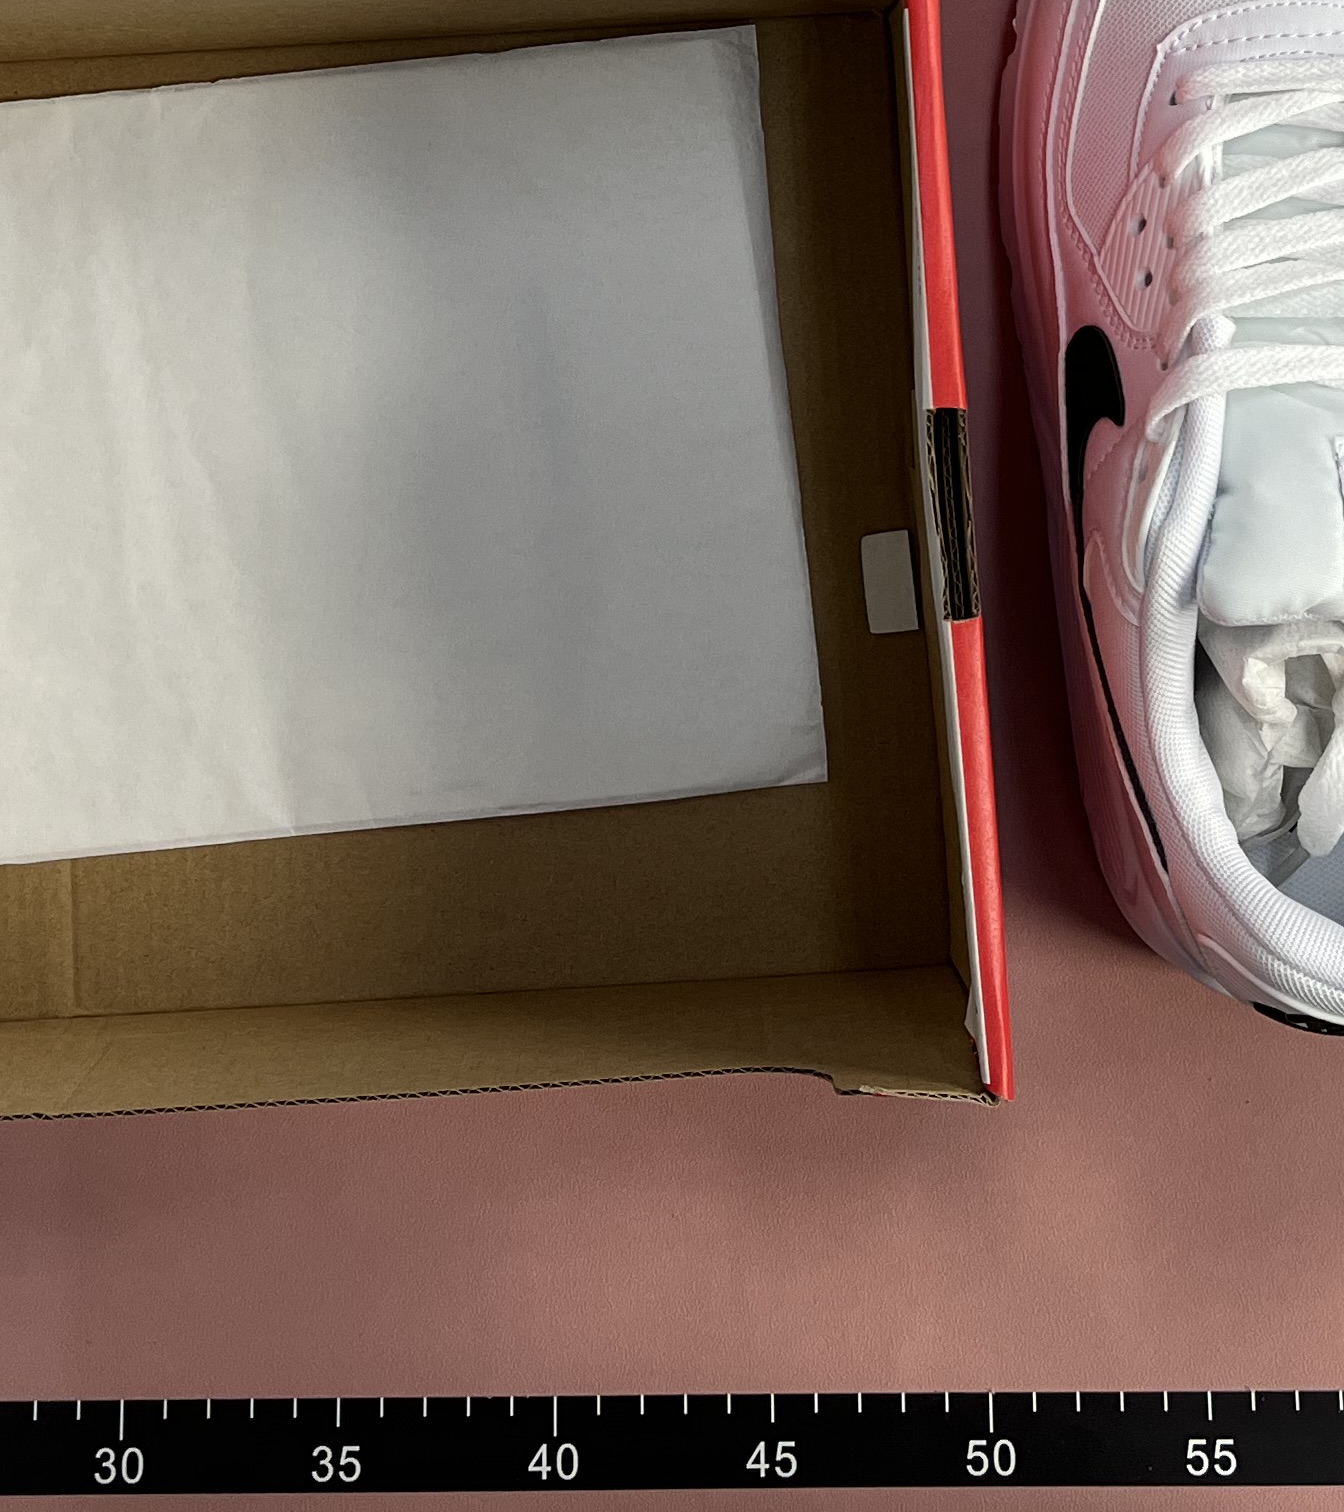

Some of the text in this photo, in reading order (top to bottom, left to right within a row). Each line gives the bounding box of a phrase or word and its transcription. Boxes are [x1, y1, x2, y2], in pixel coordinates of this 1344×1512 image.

[94, 1447, 144, 1484] 30
[311, 1445, 361, 1483] 35
[527, 1443, 579, 1481] 40
[746, 1441, 798, 1478] 45
[966, 1439, 1016, 1477] 50
[1186, 1438, 1237, 1476] 55
